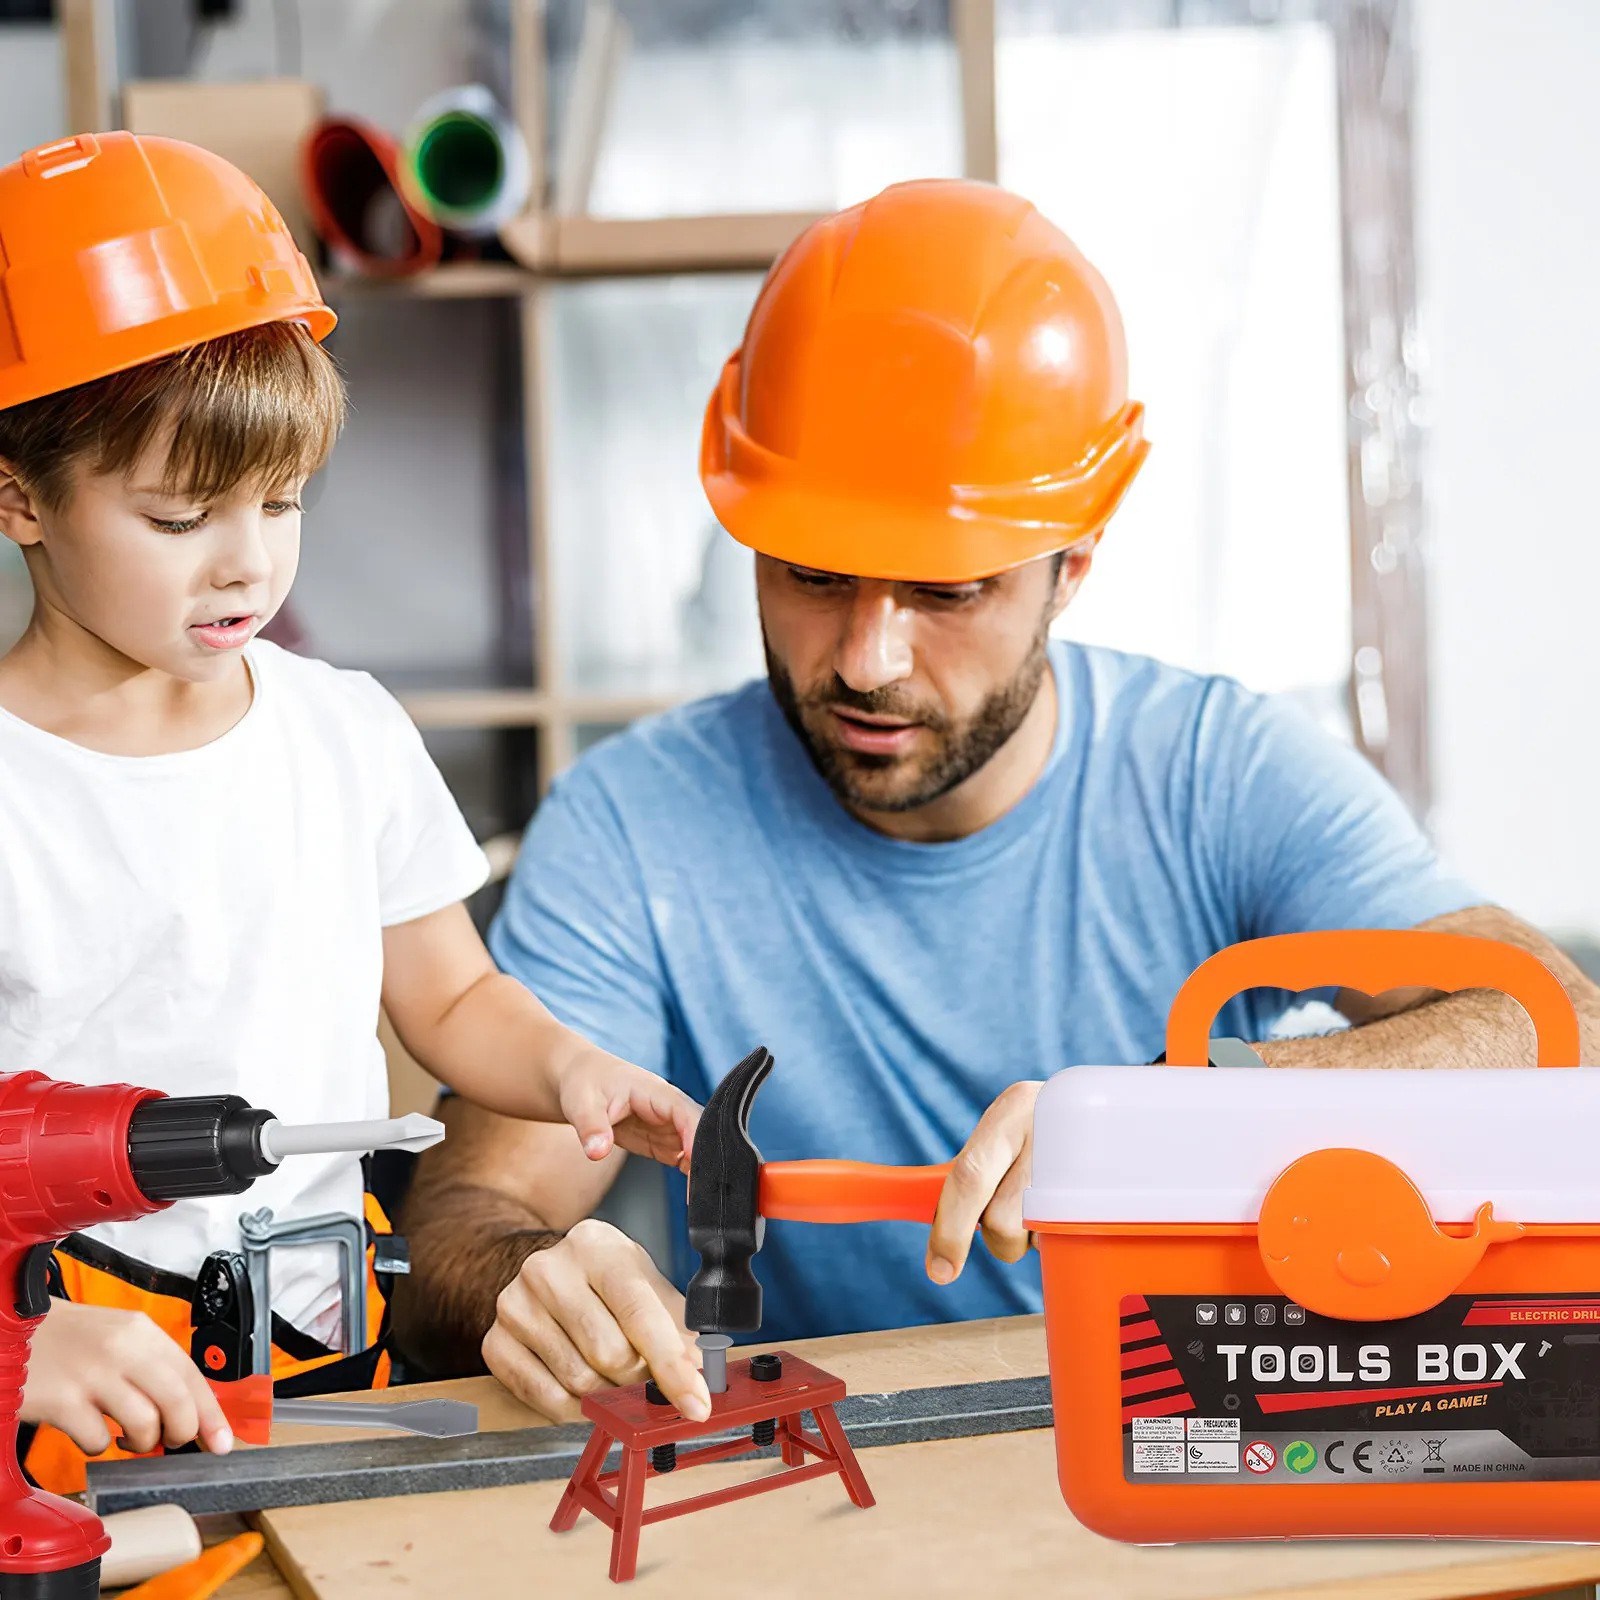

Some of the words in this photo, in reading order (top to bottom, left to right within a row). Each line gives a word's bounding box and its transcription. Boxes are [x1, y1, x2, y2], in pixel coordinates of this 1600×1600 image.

[1510, 1311, 1569, 1320] ELECTRIC
[1216, 1345, 1392, 1382] TOOLS
[1417, 1342, 1526, 1382] BOX
[1374, 1402, 1417, 1418] PLAY
[1420, 1400, 1432, 1413] A
[1436, 1394, 1488, 1412] GAME!
[1379, 1440, 1413, 1455] PLEASE
[1248, 1459, 1261, 1467] 0-3
[1324, 1440, 1373, 1474] CE
[1380, 1460, 1413, 1474] RECYCLE
[1453, 1464, 1481, 1472] MADE
[1483, 1464, 1493, 1472] IN
[1495, 1463, 1526, 1472] CHINA
